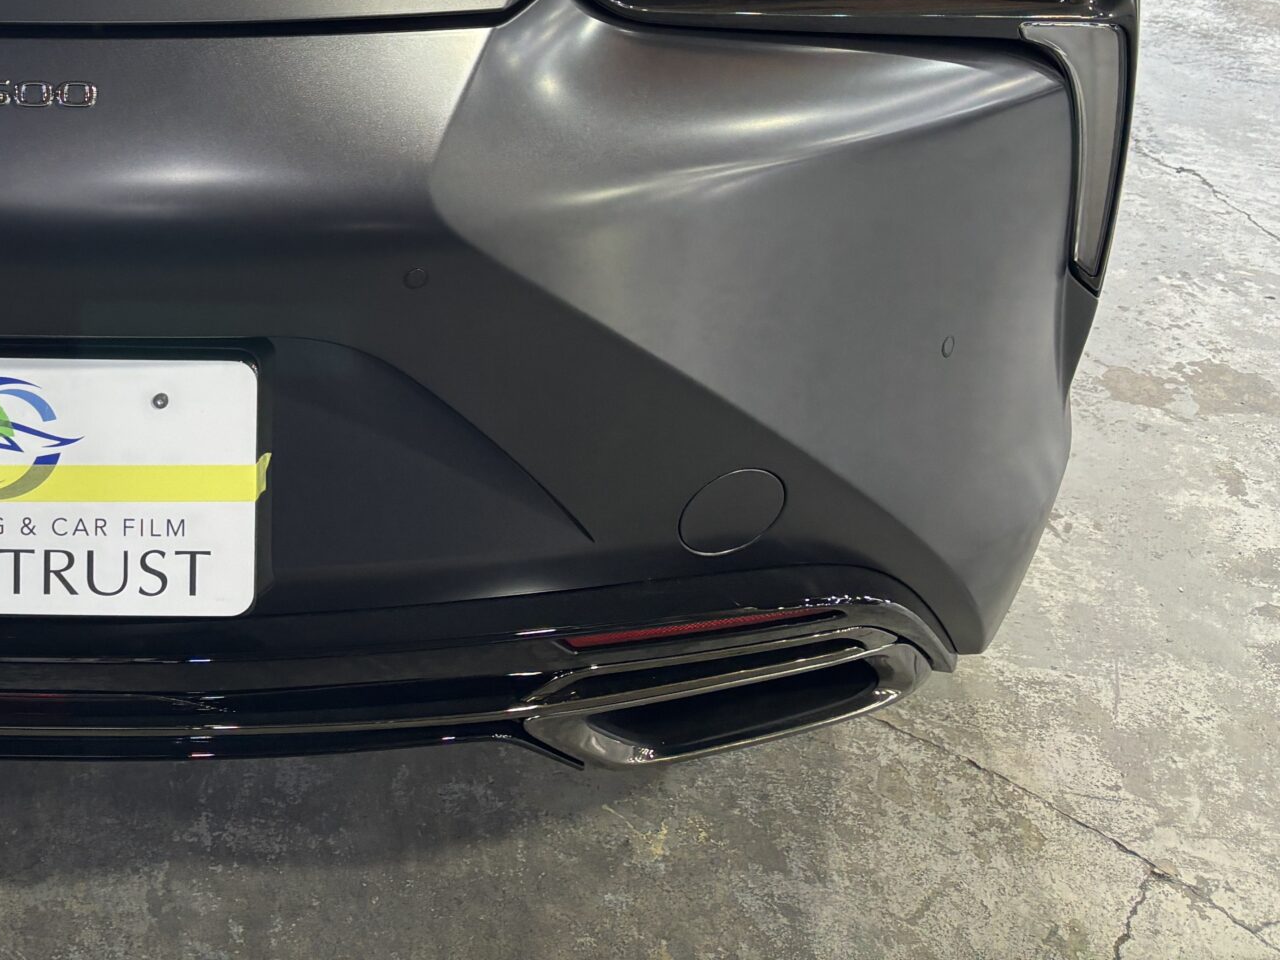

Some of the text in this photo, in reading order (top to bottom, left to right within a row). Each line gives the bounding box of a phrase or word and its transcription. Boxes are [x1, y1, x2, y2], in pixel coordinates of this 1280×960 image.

[20, 516, 38, 536] &
[51, 517, 108, 537] CAR
[122, 518, 186, 538] FILM
